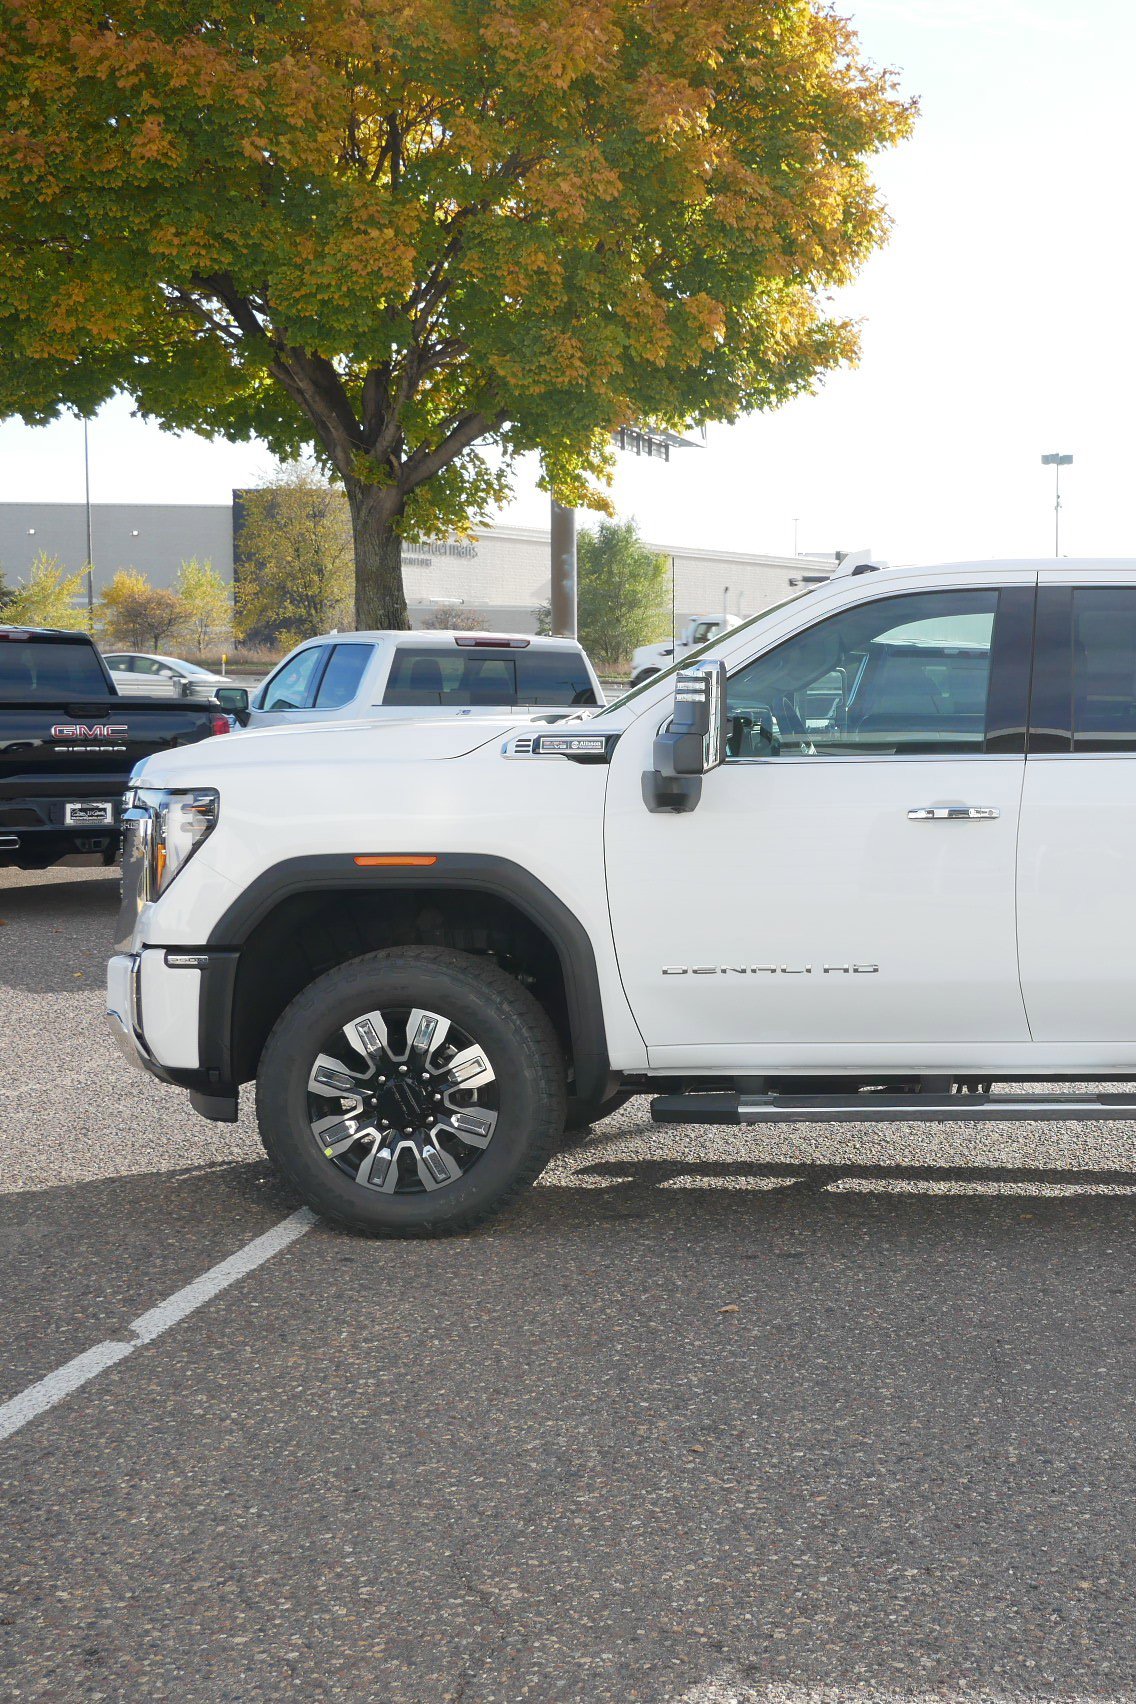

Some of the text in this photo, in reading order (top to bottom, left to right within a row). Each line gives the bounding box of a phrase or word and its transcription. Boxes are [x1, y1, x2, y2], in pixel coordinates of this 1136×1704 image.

[51, 724, 128, 739] GMC
[662, 963, 879, 975] DENALI HD
